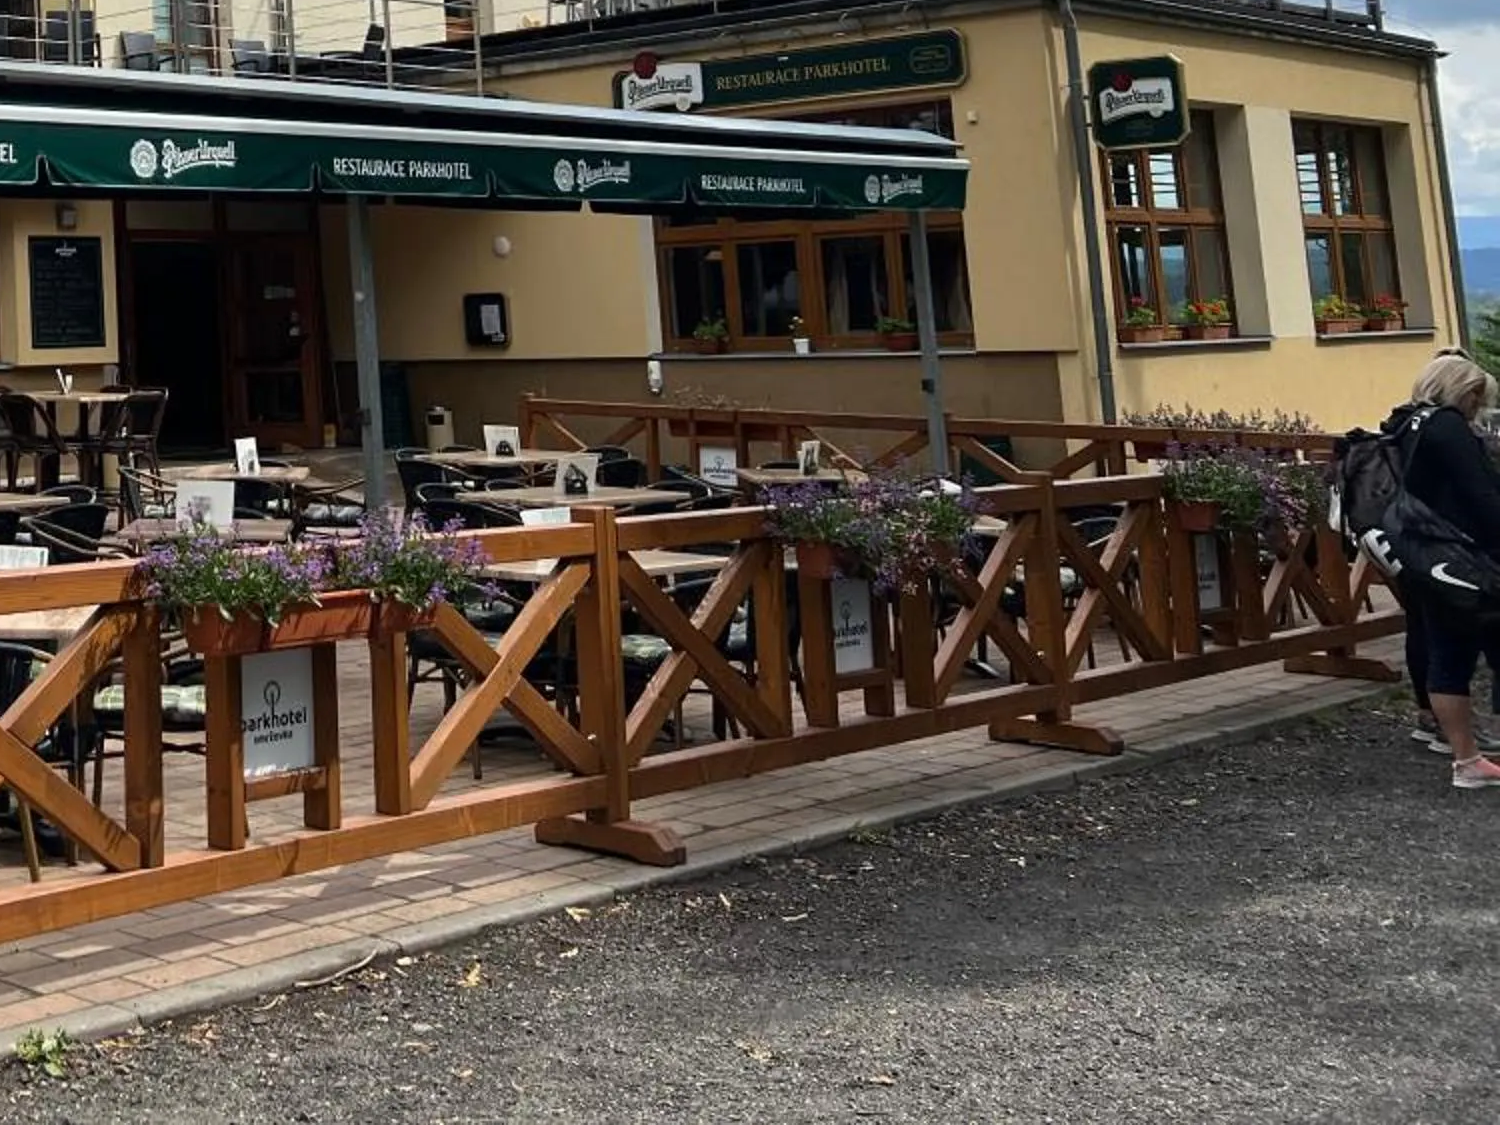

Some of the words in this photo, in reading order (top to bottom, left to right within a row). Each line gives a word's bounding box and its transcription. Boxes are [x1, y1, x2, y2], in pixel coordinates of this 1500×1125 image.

[715, 67, 799, 91] RESTAURACE
[803, 57, 892, 80] PARKHOTEL
[333, 157, 406, 177] RESTAURACE
[408, 160, 473, 180] PARKHOTEL
[701, 174, 755, 192] RESTAURACE
[757, 176, 807, 194] PARKHOTEL
